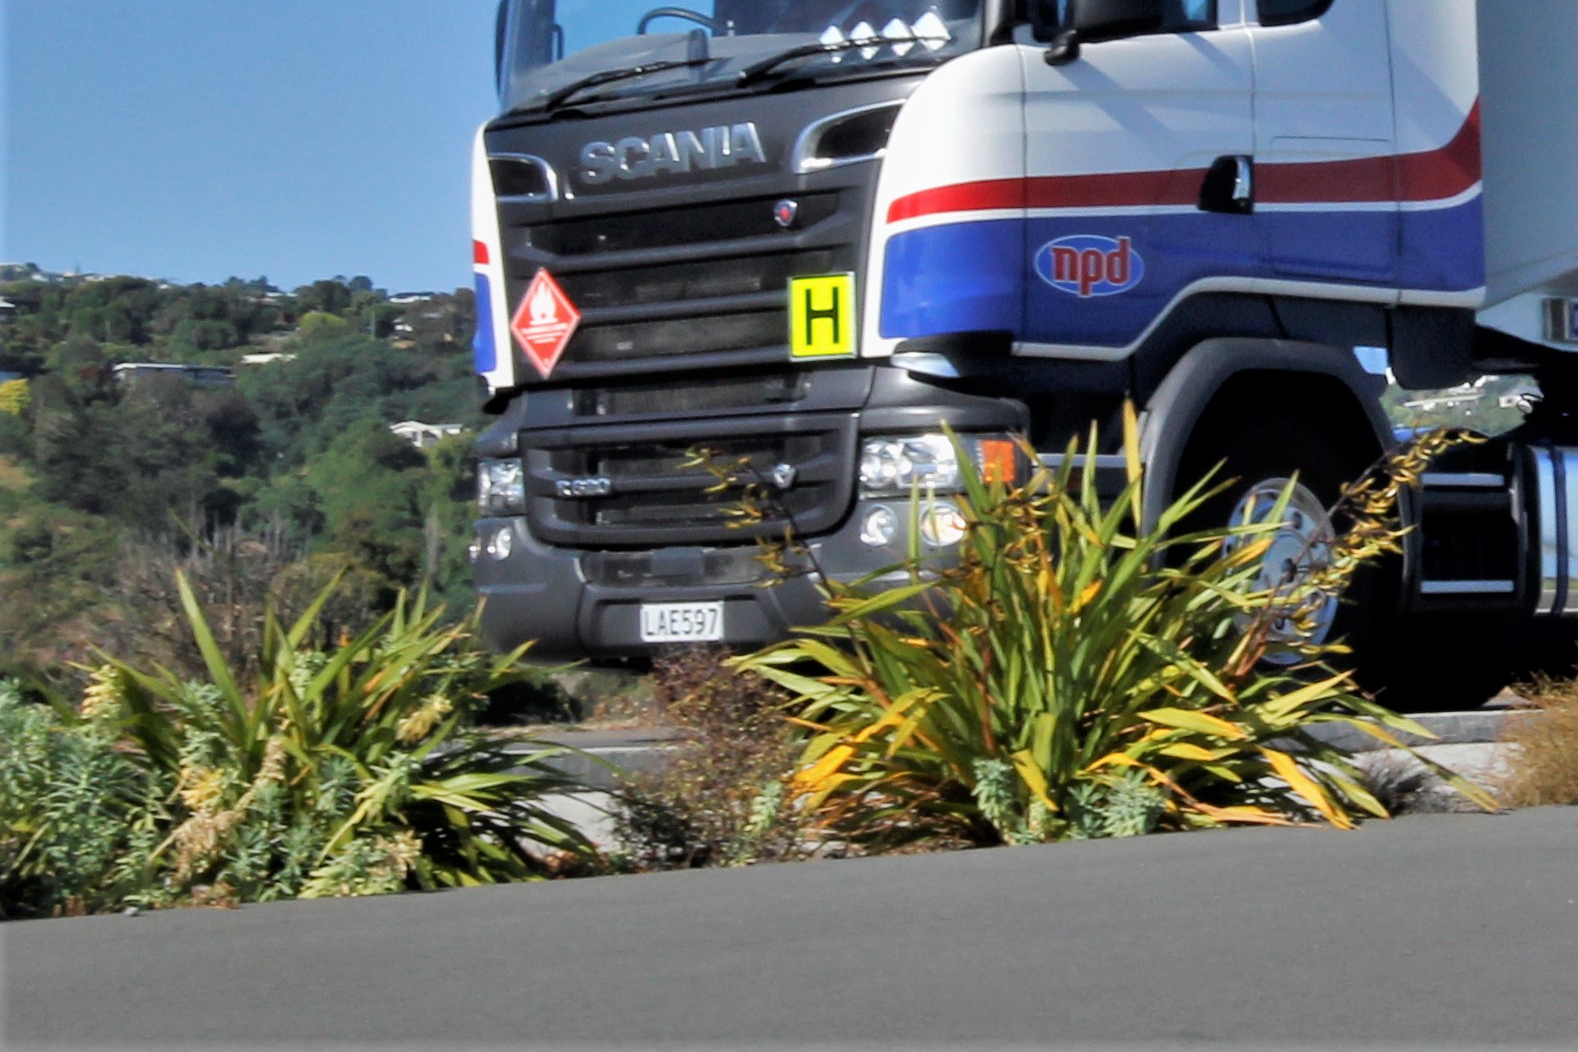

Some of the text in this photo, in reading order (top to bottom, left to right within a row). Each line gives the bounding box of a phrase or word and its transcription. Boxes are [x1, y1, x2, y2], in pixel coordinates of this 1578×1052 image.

[579, 121, 767, 185] SCANIA
[1049, 235, 1131, 298] npd
[805, 286, 840, 346] H
[643, 608, 718, 637] LAE597
